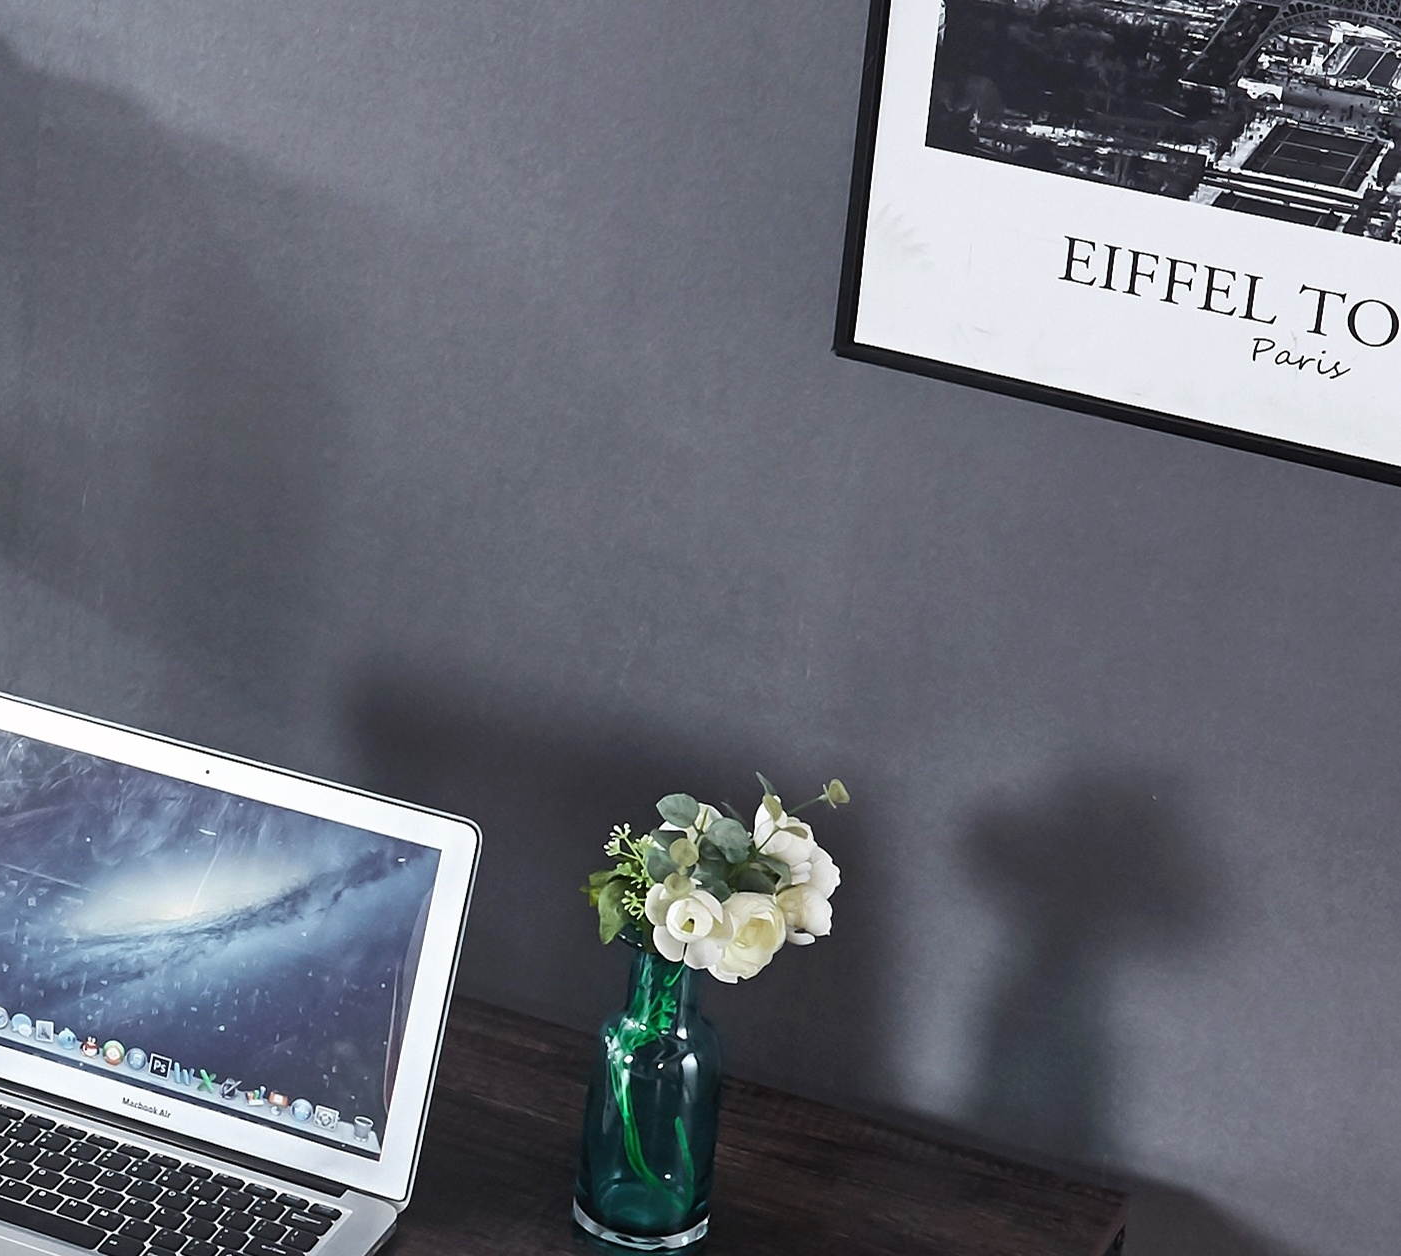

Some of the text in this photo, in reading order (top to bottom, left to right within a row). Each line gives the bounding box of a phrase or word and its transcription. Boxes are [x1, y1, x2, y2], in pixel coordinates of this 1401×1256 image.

[1058, 235, 1400, 347] EIFFEL TO
[1251, 337, 1351, 379] Paris
[153, 1059, 167, 1073] Ps
